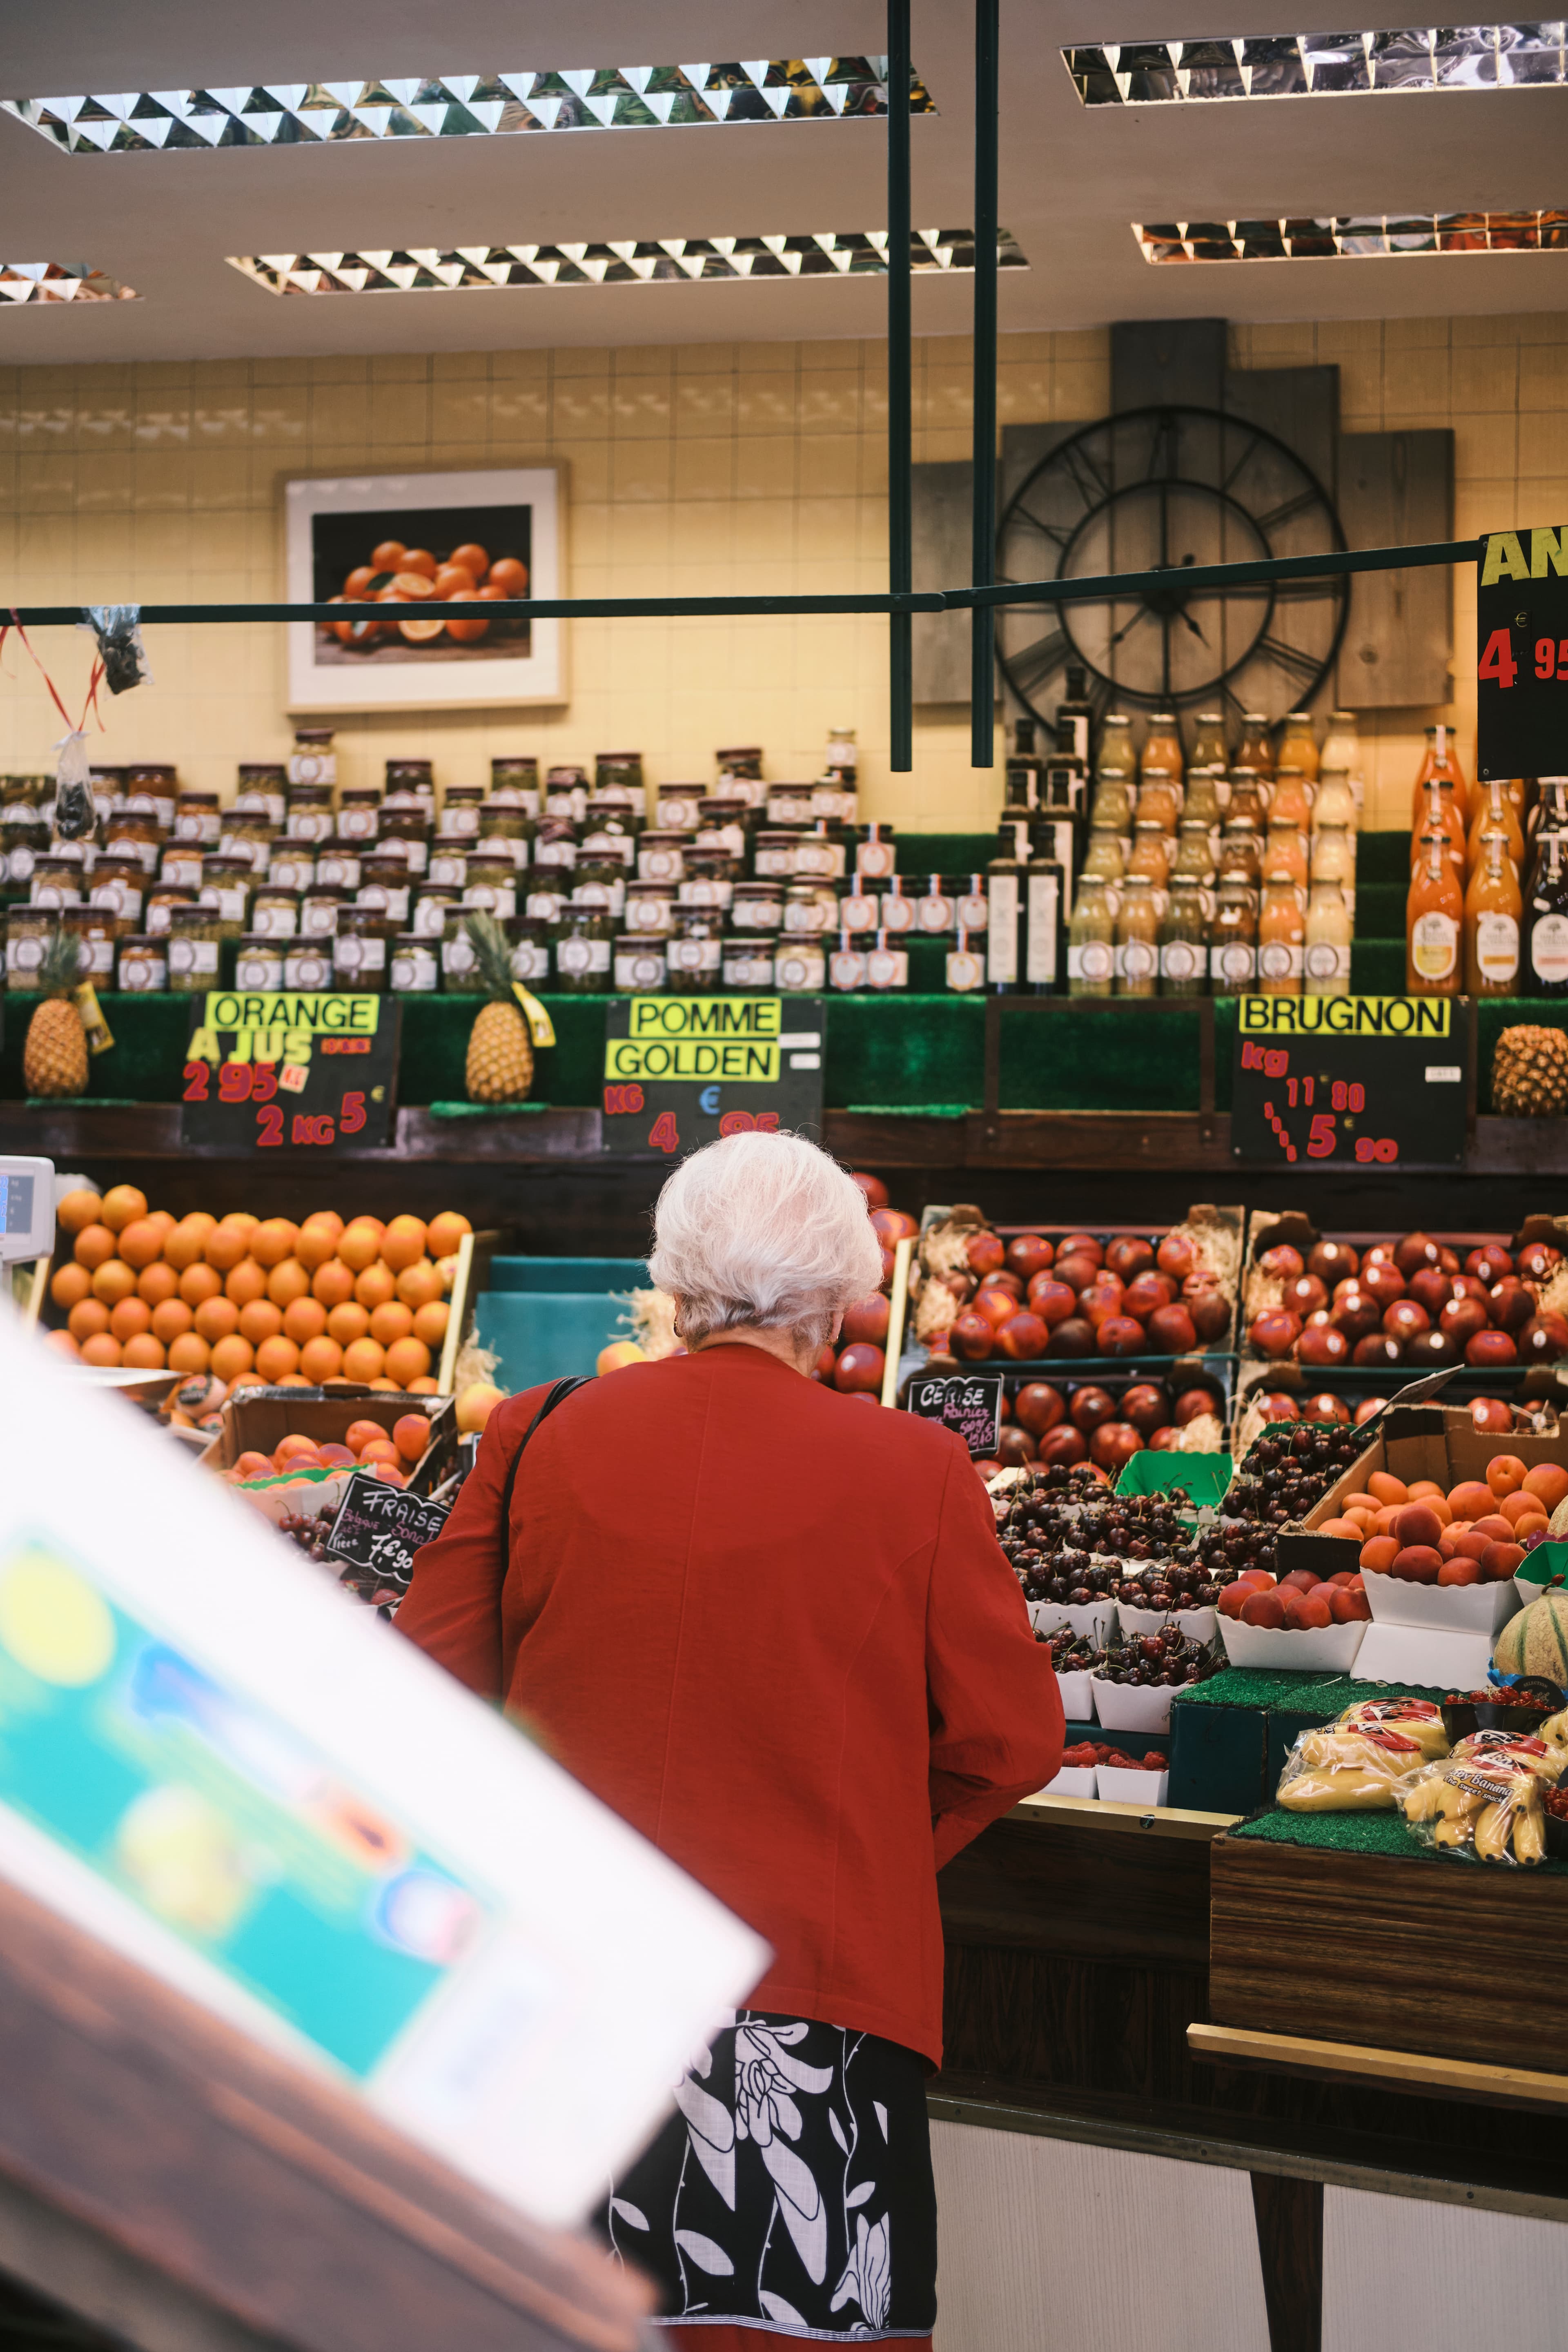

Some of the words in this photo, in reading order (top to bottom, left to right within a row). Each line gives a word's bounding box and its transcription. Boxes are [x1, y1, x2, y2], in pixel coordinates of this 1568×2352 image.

[1481, 526, 1568, 586] AN
[1514, 612, 1528, 627] €
[1478, 628, 1518, 688] 4
[215, 997, 371, 1028] ORANGE
[637, 1002, 775, 1033] POMME
[1245, 997, 1444, 1032] BRUGNON
[186, 1027, 221, 1062] A
[227, 1029, 312, 1065] JUS
[615, 1045, 771, 1076] GOLDEN
[1241, 1041, 1289, 1078] kg
[183, 1060, 209, 1101] 2
[218, 1062, 278, 1102] 95
[604, 1083, 644, 1114] KG
[1286, 1076, 1314, 1107] 11
[1332, 1080, 1365, 1113] 80
[699, 1085, 721, 1114] €
[256, 1104, 284, 1146] 2
[292, 1114, 334, 1145] KG
[340, 1091, 367, 1133] 5
[648, 1111, 679, 1153] 4
[1307, 1114, 1336, 1158] 5
[1355, 1137, 1399, 1163] 90
[920, 1383, 985, 1406] CERISE
[363, 1491, 443, 1532] FRAISE
[1443, 1775, 1458, 1786] The
[1458, 1783, 1482, 1795] sweet
[1482, 1793, 1503, 1804] snack
[1448, 1768, 1472, 1781] aby
[1470, 1773, 1515, 1797] Banana
